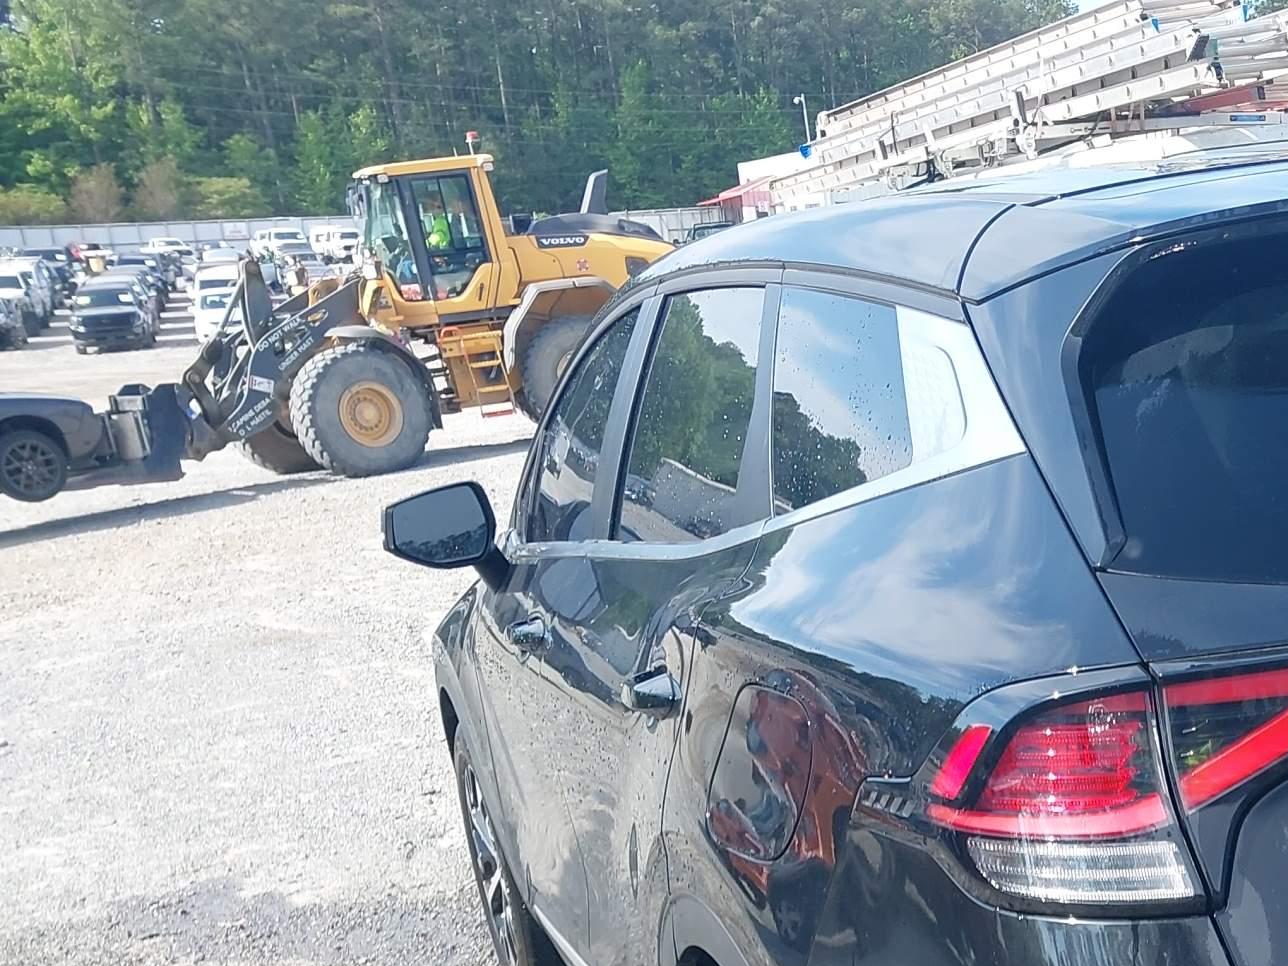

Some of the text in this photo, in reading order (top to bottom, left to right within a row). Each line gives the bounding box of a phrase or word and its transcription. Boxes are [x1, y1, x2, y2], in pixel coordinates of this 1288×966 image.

[539, 236, 585, 246] VOLVO
[258, 340, 269, 352] DO
[268, 329, 283, 344] NOT
